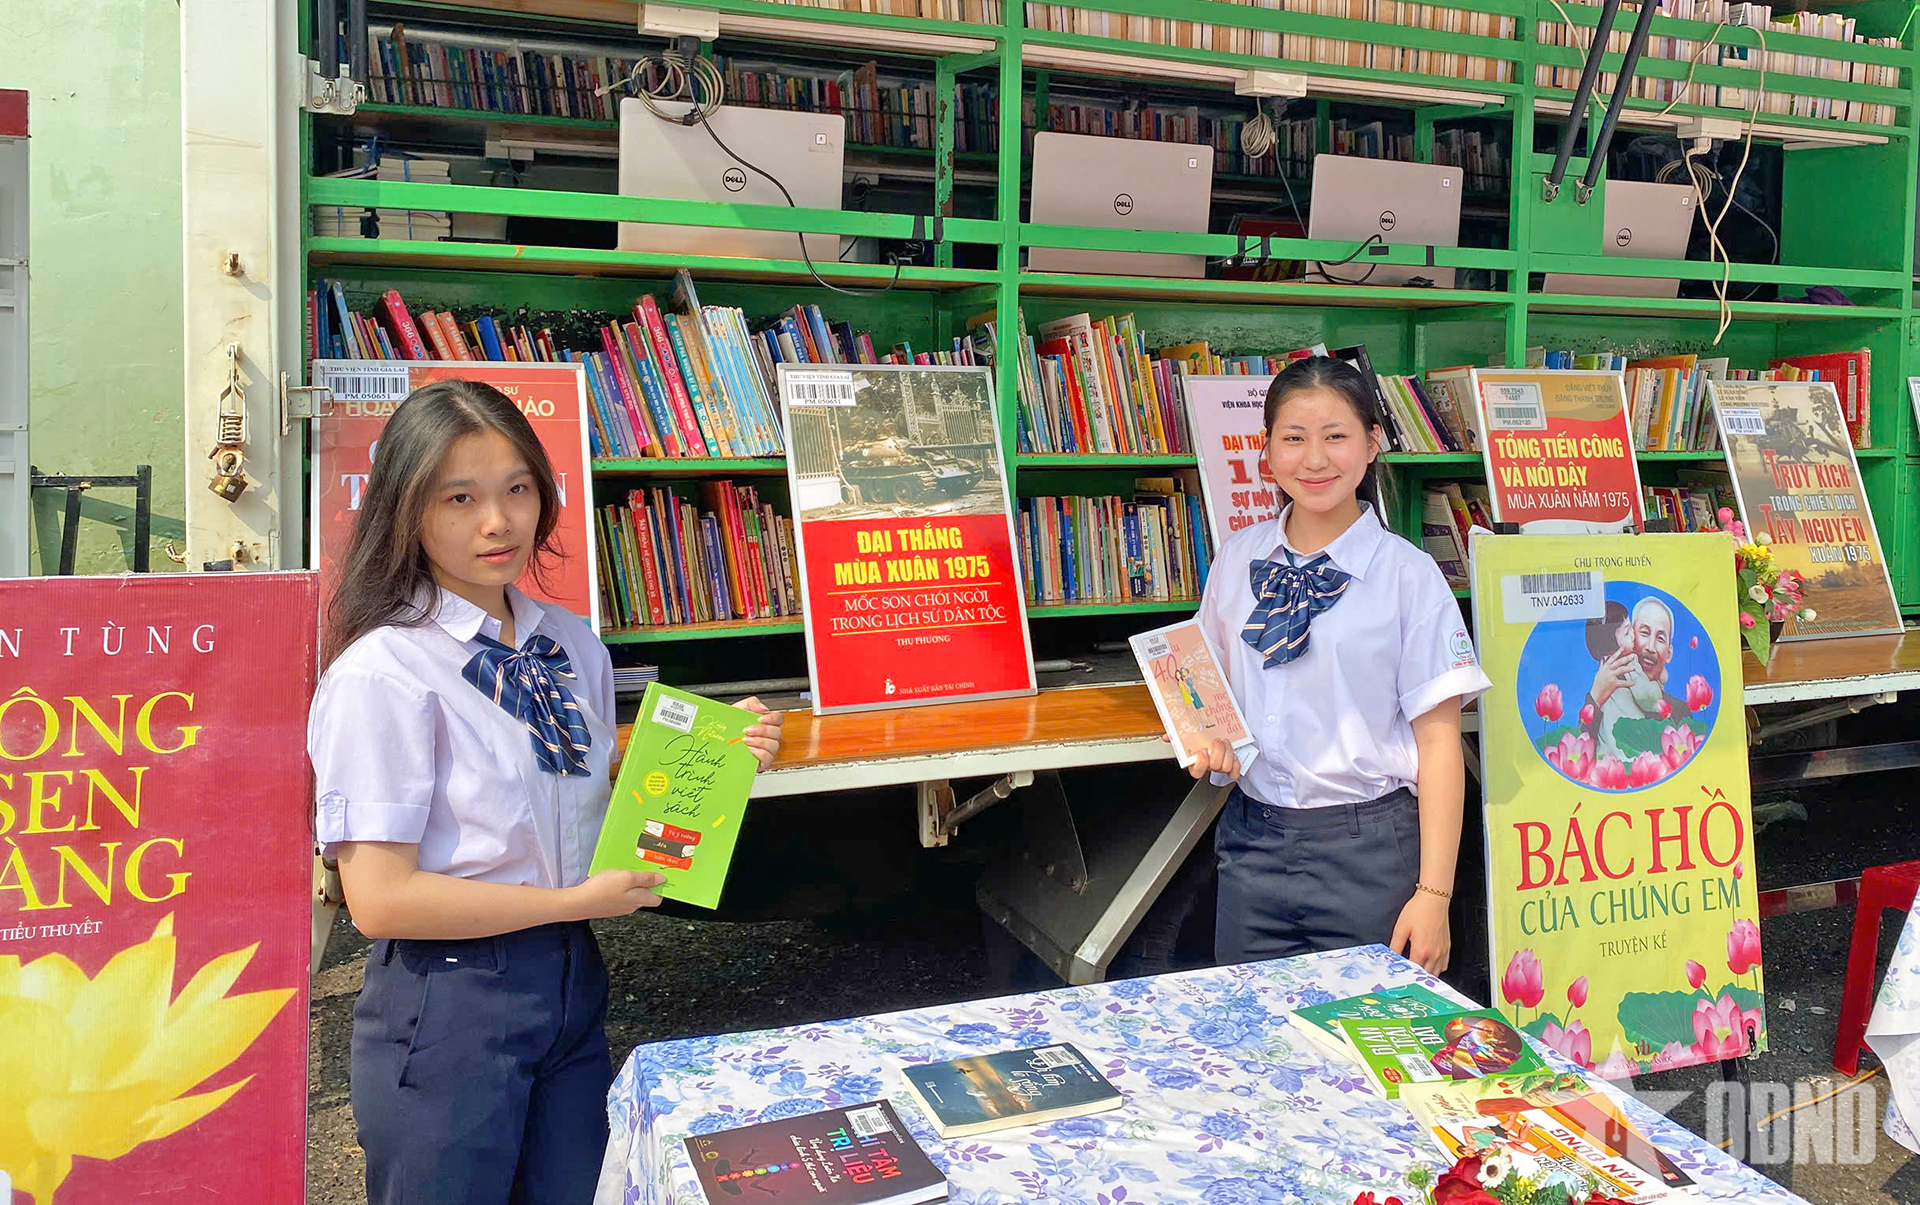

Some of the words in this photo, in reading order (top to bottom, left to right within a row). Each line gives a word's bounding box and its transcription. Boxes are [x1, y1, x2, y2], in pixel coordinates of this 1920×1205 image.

[726, 176, 744, 184] DELL
[652, 325, 665, 343] 366
[672, 329, 685, 347] KHÁM
[1222, 400, 1236, 410] VIỆN
[1236, 400, 1251, 409] KHOA
[1252, 400, 1264, 409] HỌC
[1222, 435, 1244, 454] ĐẠI
[1495, 431, 1540, 459] TỔNG
[1542, 431, 1578, 459] TIẾN
[1581, 433, 1624, 459] CÔNG
[1500, 462, 1524, 488] VÀ
[1528, 458, 1554, 487] NỔI
[1556, 462, 1587, 492] DẬY
[1763, 448, 1812, 489] TRUY
[1814, 458, 1851, 489] KÍCH
[1232, 490, 1250, 511] SỰ
[1506, 490, 1534, 509] MÙA
[1537, 490, 1571, 508] XUÂN
[1572, 490, 1600, 508] NĂM
[1602, 492, 1630, 508] 1975
[1770, 495, 1802, 512] TRONG
[1804, 490, 1832, 511] CHIẾN
[1833, 494, 1858, 513] DỊCH
[1229, 509, 1256, 532] CỦA
[1760, 504, 1795, 544] TÂY
[1800, 513, 1866, 544] NGUYÊN
[856, 530, 892, 557] ĐẠI
[896, 521, 963, 552] THẮNG
[1574, 556, 1592, 569] CHU
[1594, 555, 1624, 570] TRỌNG
[1809, 544, 1844, 564] XUÂN
[1846, 546, 1872, 562] 1975
[834, 559, 882, 586] MÙA
[888, 554, 940, 583] XUÂN
[944, 555, 990, 579] 1975
[844, 592, 879, 612] MỐC
[881, 595, 911, 611] SON
[914, 591, 951, 608] CHÓI
[1530, 594, 1585, 608] TNV.042633
[830, 614, 882, 632] TRONG
[885, 612, 920, 632] LỊCH
[944, 605, 978, 624] DÂN
[979, 604, 1006, 623] TỘC
[60, 620, 217, 656] TÙNG
[895, 637, 914, 647] THU
[915, 634, 951, 646] PHƯƠNG
[1154, 654, 1179, 683] 4.0
[1213, 691, 1229, 703] mẹ
[1205, 702, 1234, 718] chồng
[1216, 712, 1238, 726] hiện
[1226, 724, 1244, 735] đại
[658, 734, 726, 770] Hành
[674, 760, 716, 787] trình
[671, 786, 712, 803] viết
[662, 800, 701, 818] sách
[1513, 801, 1635, 892] BÁC
[1644, 784, 1745, 875] HỒ
[1520, 888, 1580, 937] CỦA
[1590, 877, 1690, 926] CHÚNG
[1702, 875, 1741, 911] EM
[0, 923, 37, 942] TIỂU
[39, 915, 103, 939] THUYẾT
[1599, 936, 1649, 960] TRUYỆN
[1652, 928, 1668, 952] KỂ
[1382, 1026, 1419, 1049] TRÁI
[1409, 1025, 1446, 1044] ĐẤT
[825, 1127, 854, 1154] TRỊ
[1550, 1126, 1605, 1163] ĐỘNG
[838, 1152, 874, 1186] LIỆU
[865, 1147, 901, 1180] TÂM
[1602, 1163, 1643, 1187] VẬN
